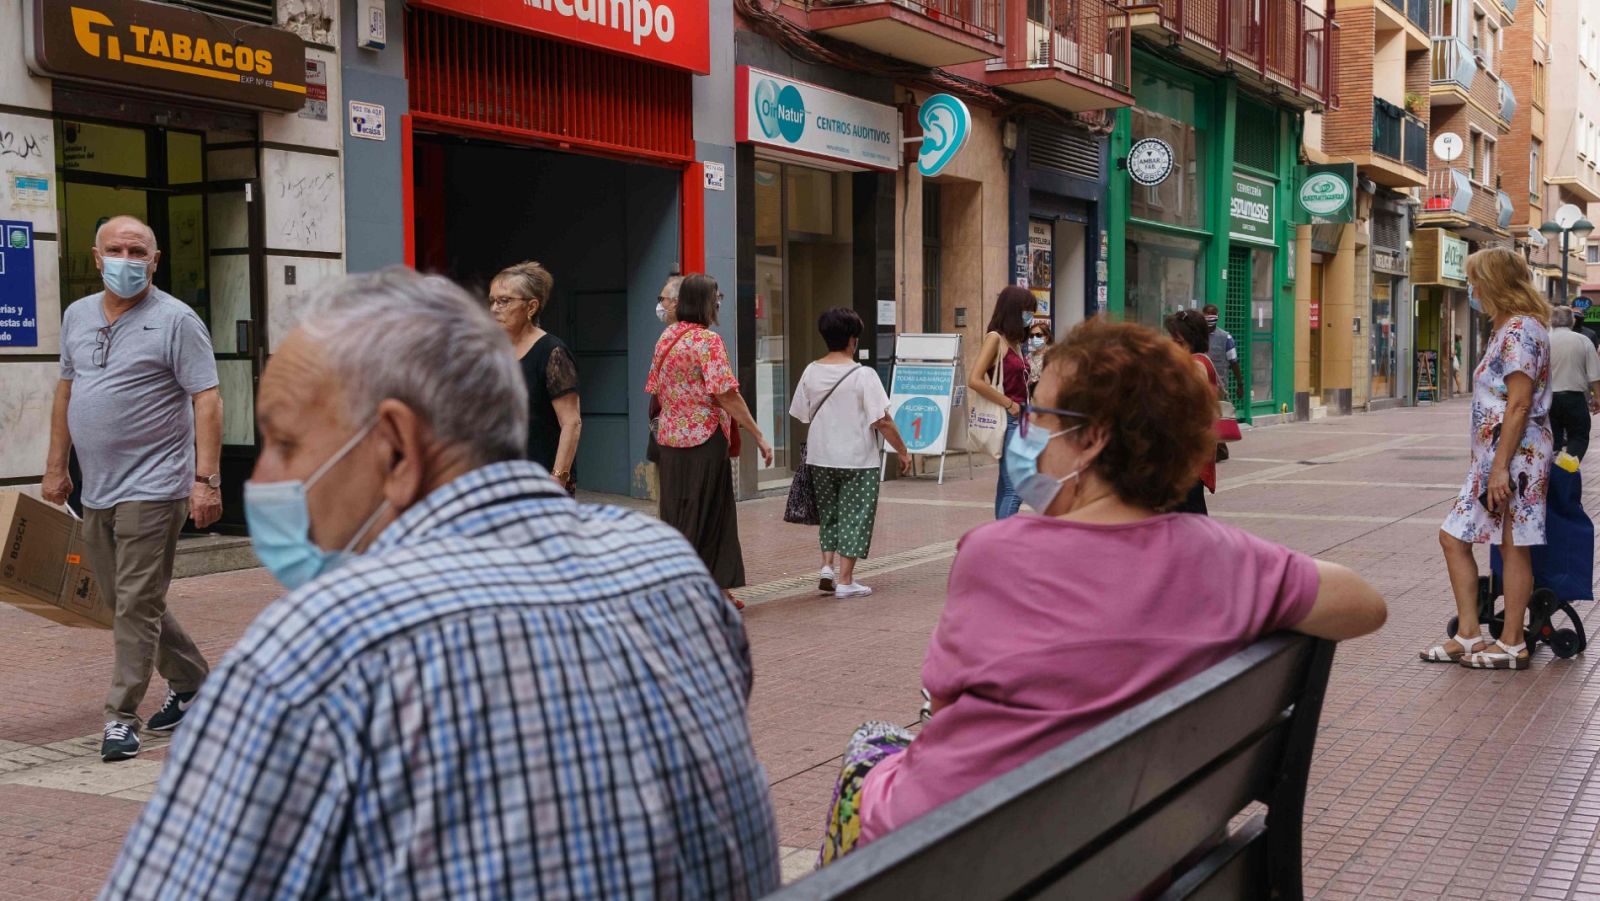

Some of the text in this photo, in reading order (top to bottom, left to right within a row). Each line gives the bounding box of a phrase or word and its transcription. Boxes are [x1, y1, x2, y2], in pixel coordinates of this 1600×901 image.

[130, 24, 273, 76] TABACOS
[816, 115, 891, 145] CENTROS AUDITIVOS
[17, 306, 23, 316] y
[22, 317, 36, 328] del
[911, 417, 922, 440] 1
[10, 517, 28, 559] BOSCH
